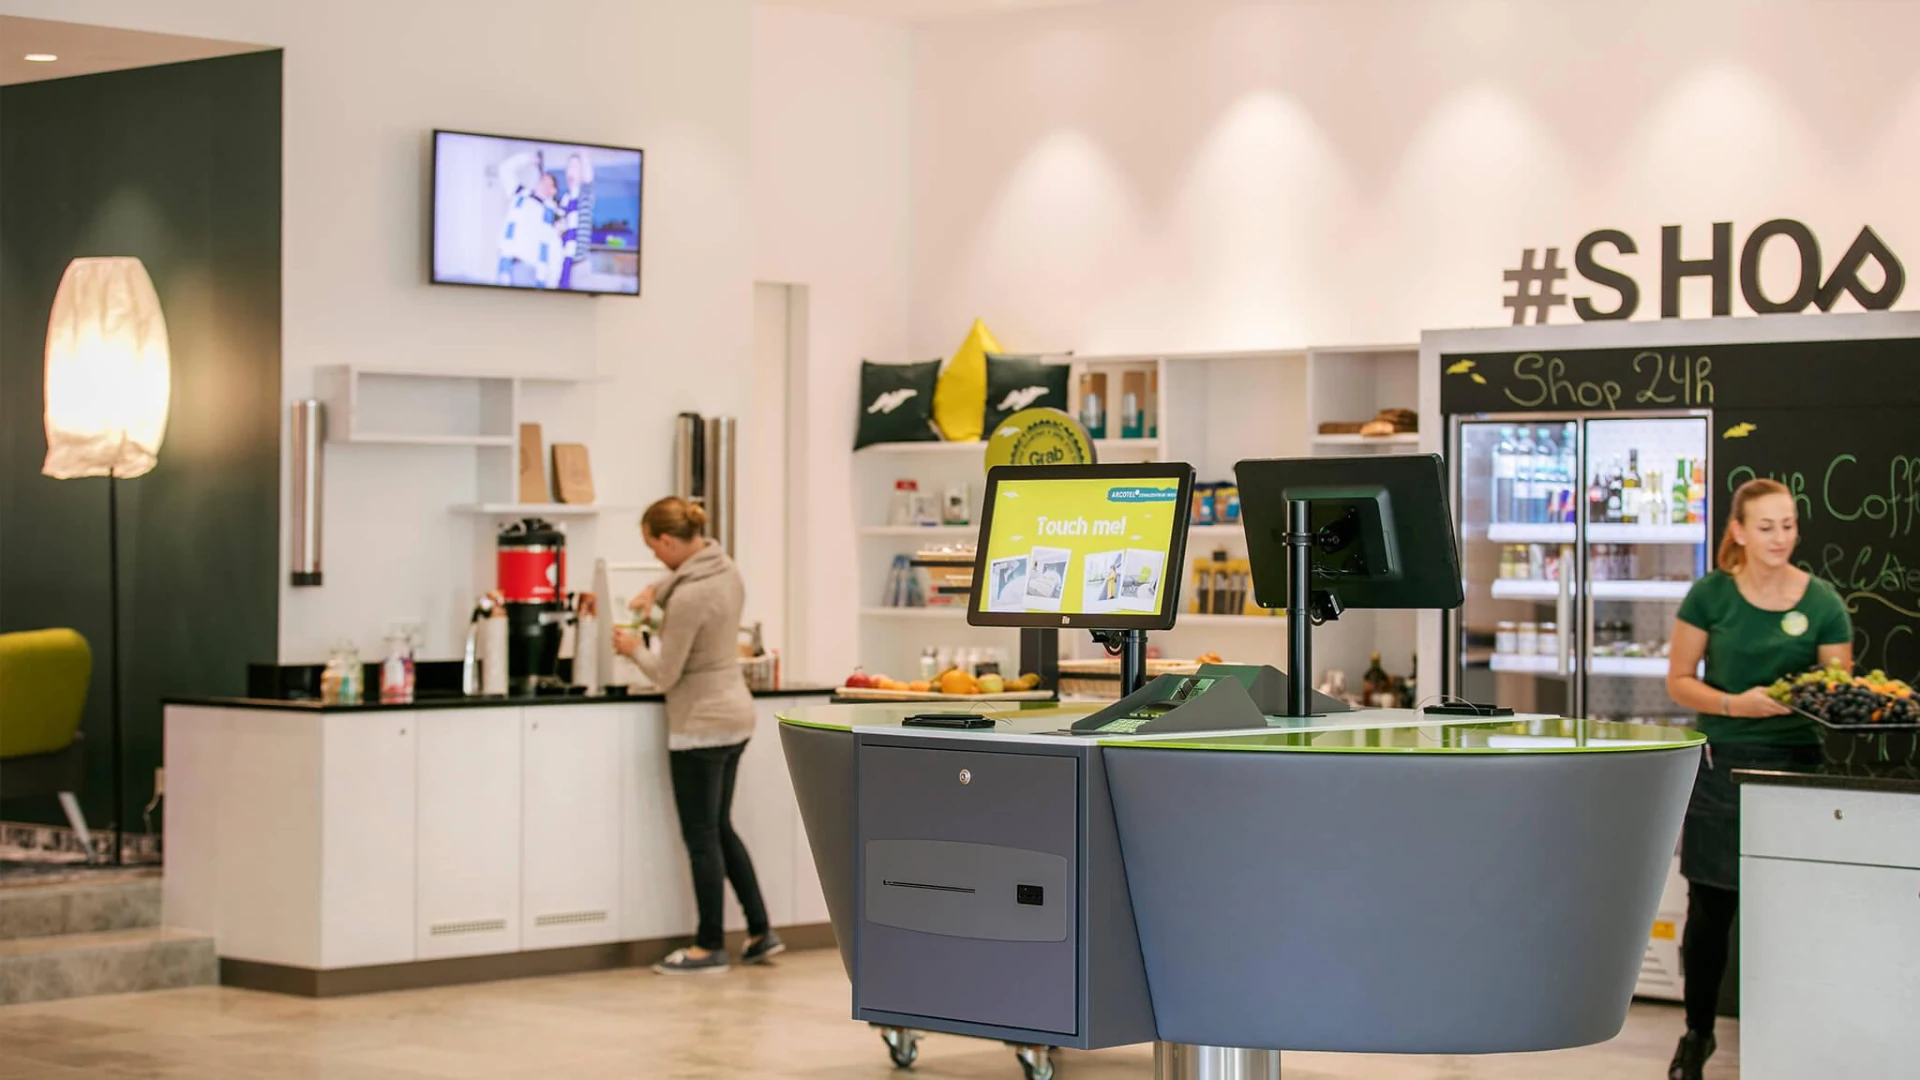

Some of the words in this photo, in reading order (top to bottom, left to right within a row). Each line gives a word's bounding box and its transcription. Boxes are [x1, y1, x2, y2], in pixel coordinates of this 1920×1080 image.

[1503, 218, 1906, 326] #SHOP
[1503, 352, 1622, 411] Shop
[1632, 351, 1715, 405] 24h
[1037, 516, 1087, 535] Touch
[1093, 516, 1126, 535] me!
[1823, 453, 1920, 539] Coff
